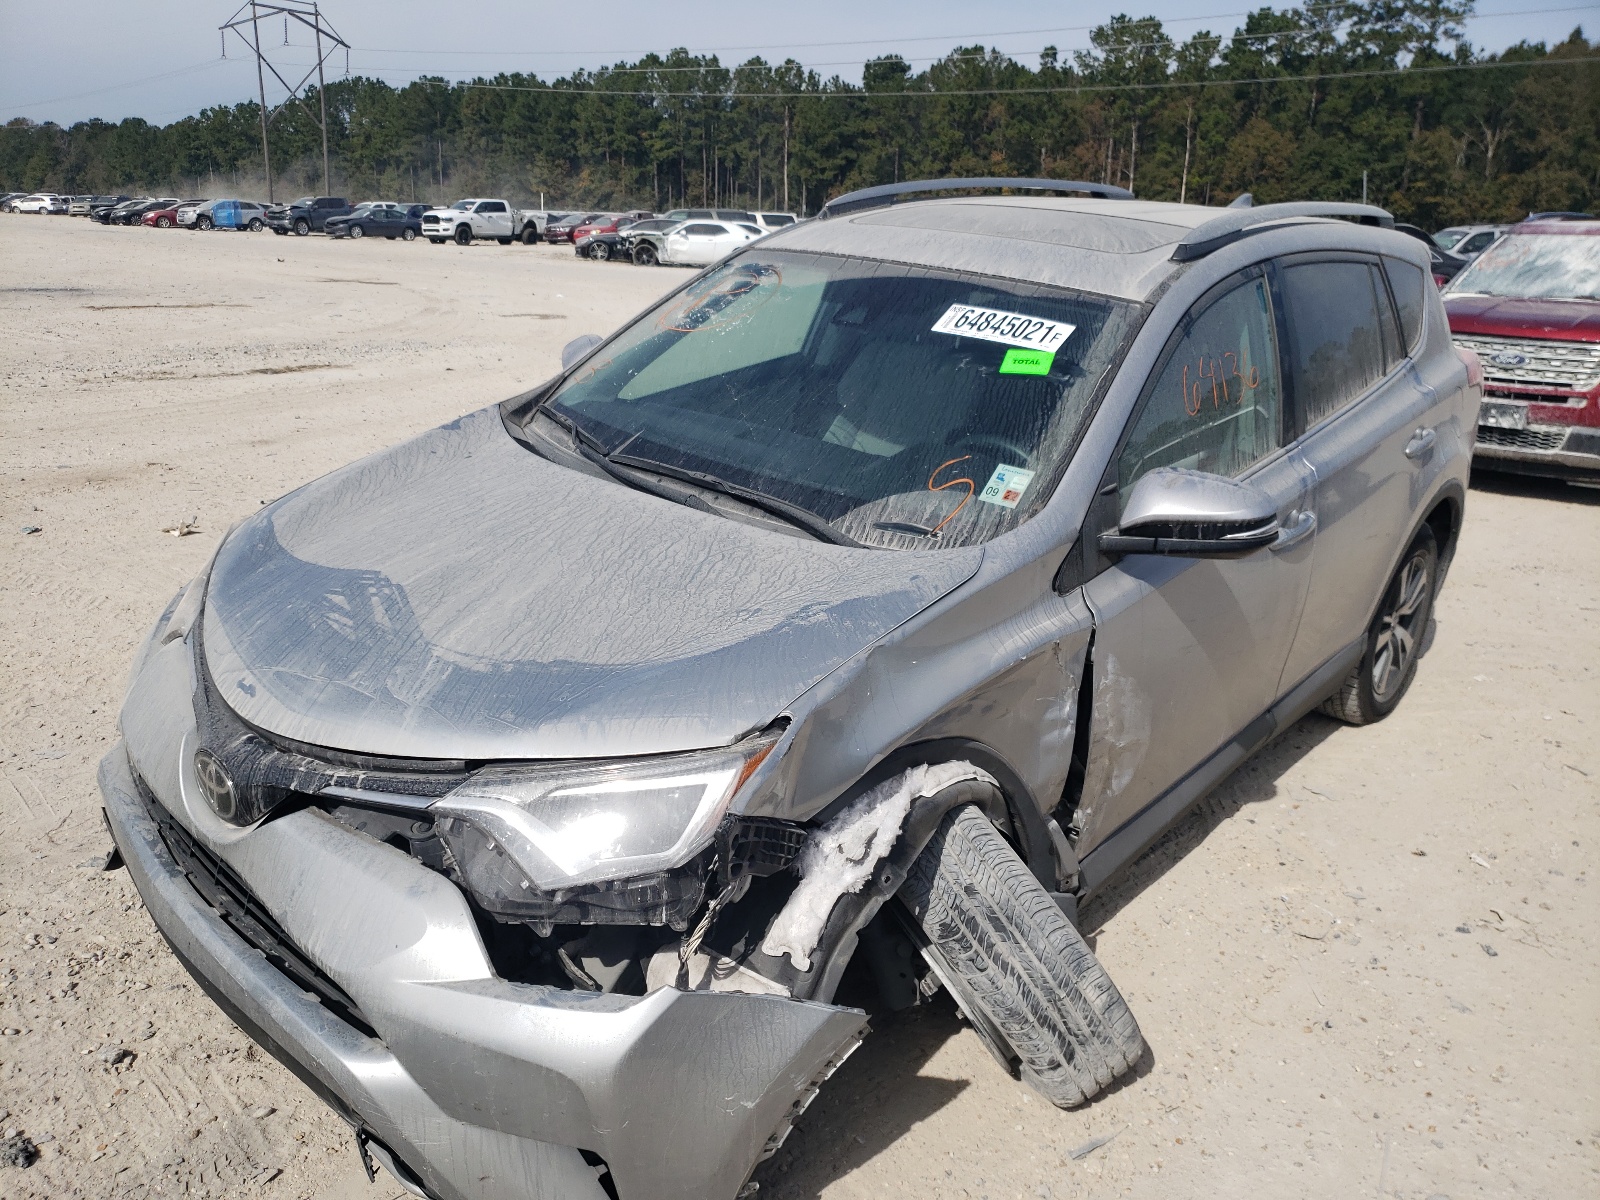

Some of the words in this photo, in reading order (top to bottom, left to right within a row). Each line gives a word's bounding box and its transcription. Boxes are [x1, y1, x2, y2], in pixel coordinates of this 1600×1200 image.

[954, 309, 1056, 343] 64845021
[1495, 355, 1520, 364] Ford
[1183, 347, 1259, 416] 64136
[985, 486, 1000, 497] 09
